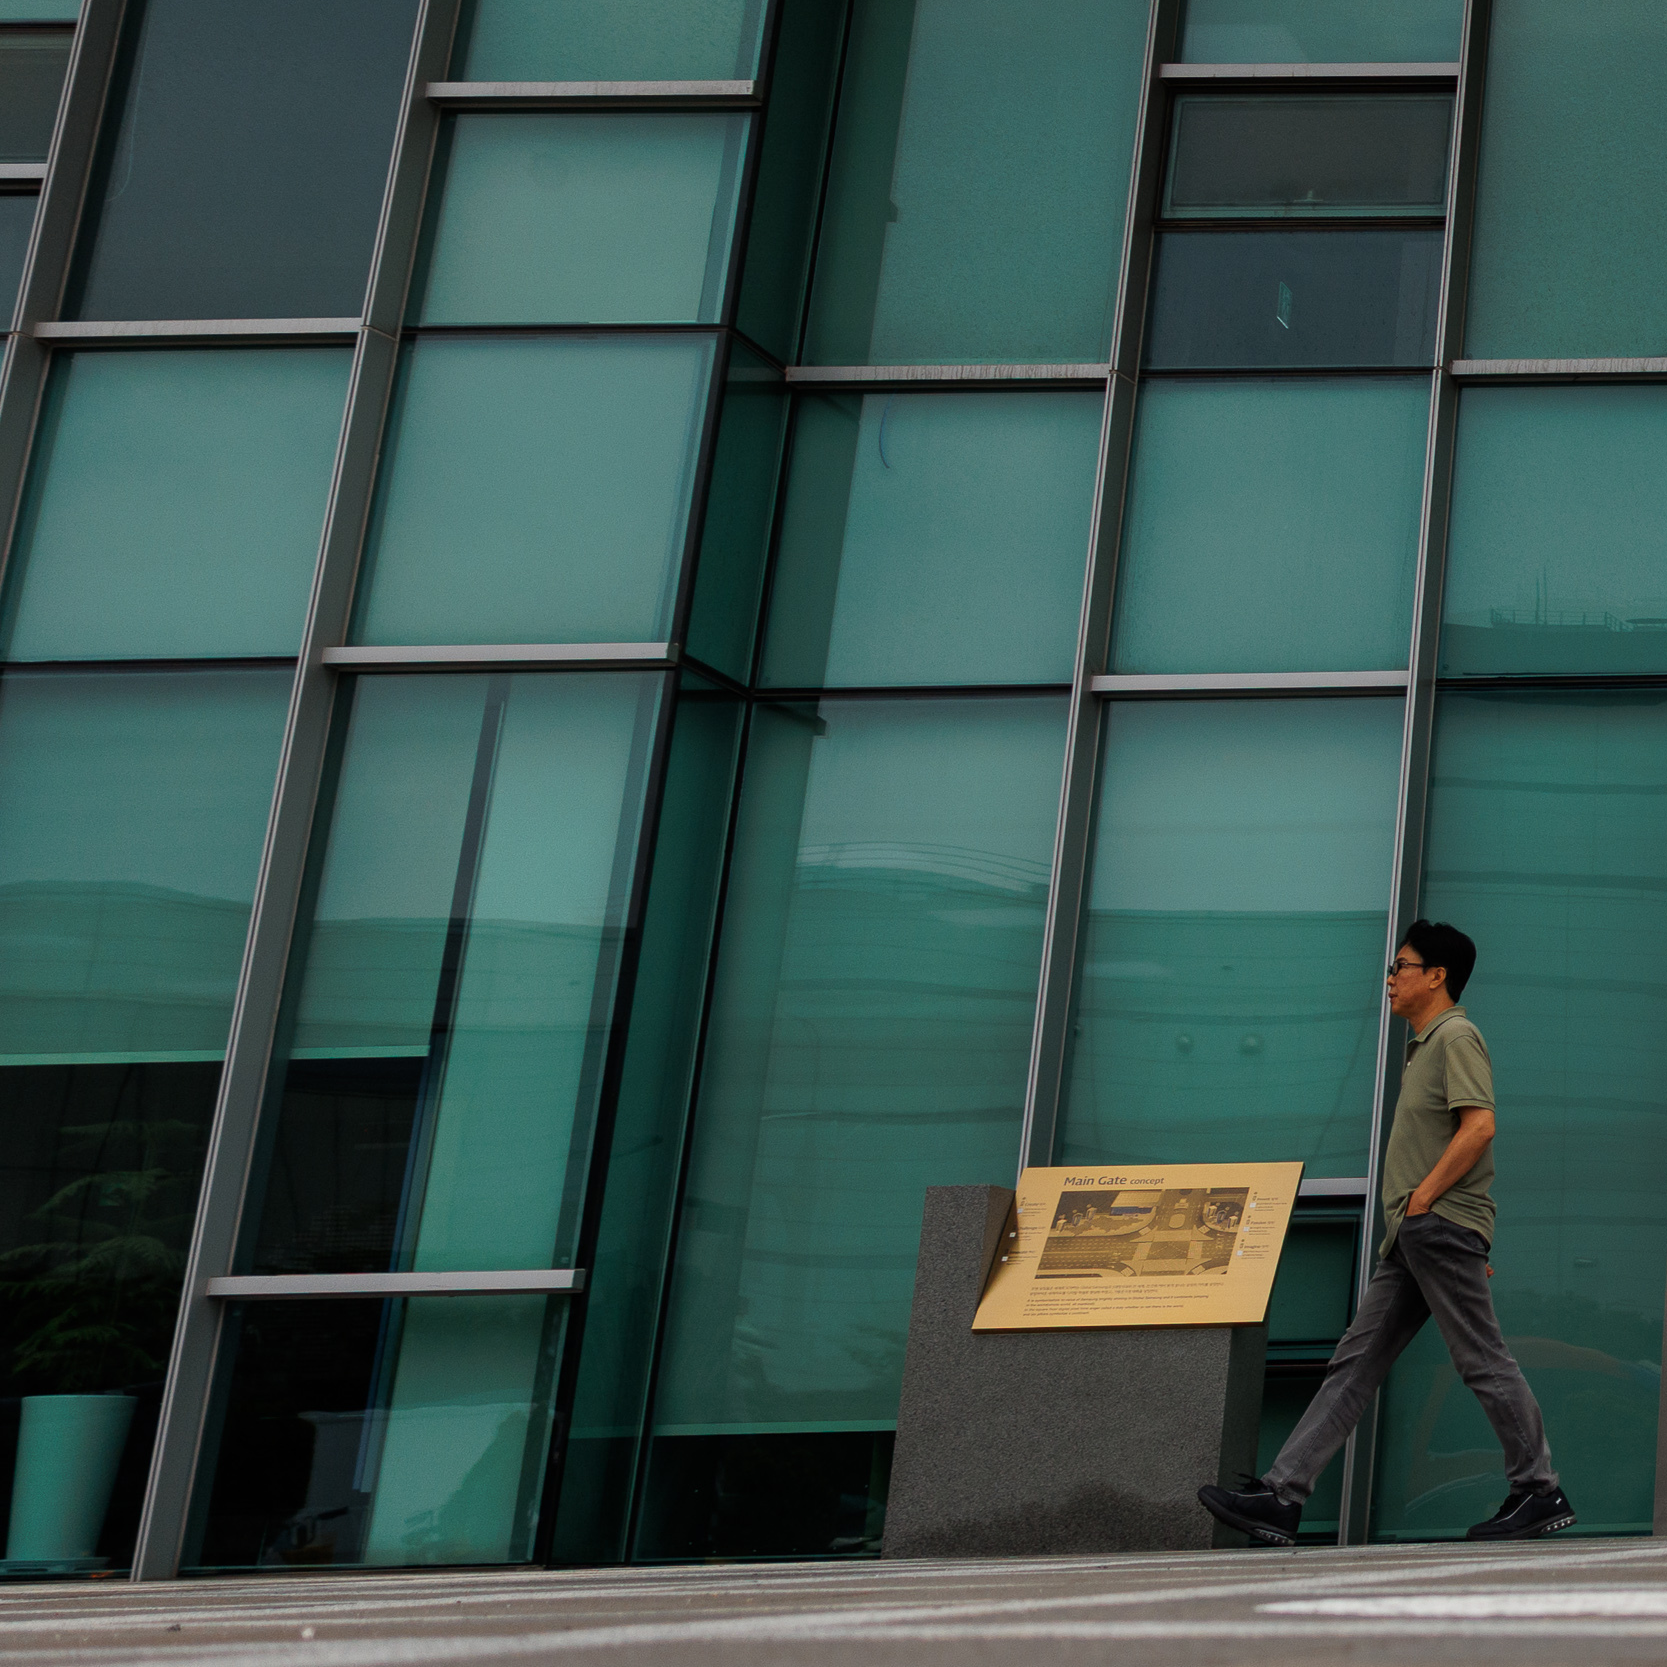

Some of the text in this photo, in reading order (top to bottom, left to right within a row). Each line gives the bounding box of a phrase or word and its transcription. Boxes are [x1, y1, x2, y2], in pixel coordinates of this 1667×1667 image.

[1064, 1175, 1164, 1186] Main Gate concept
